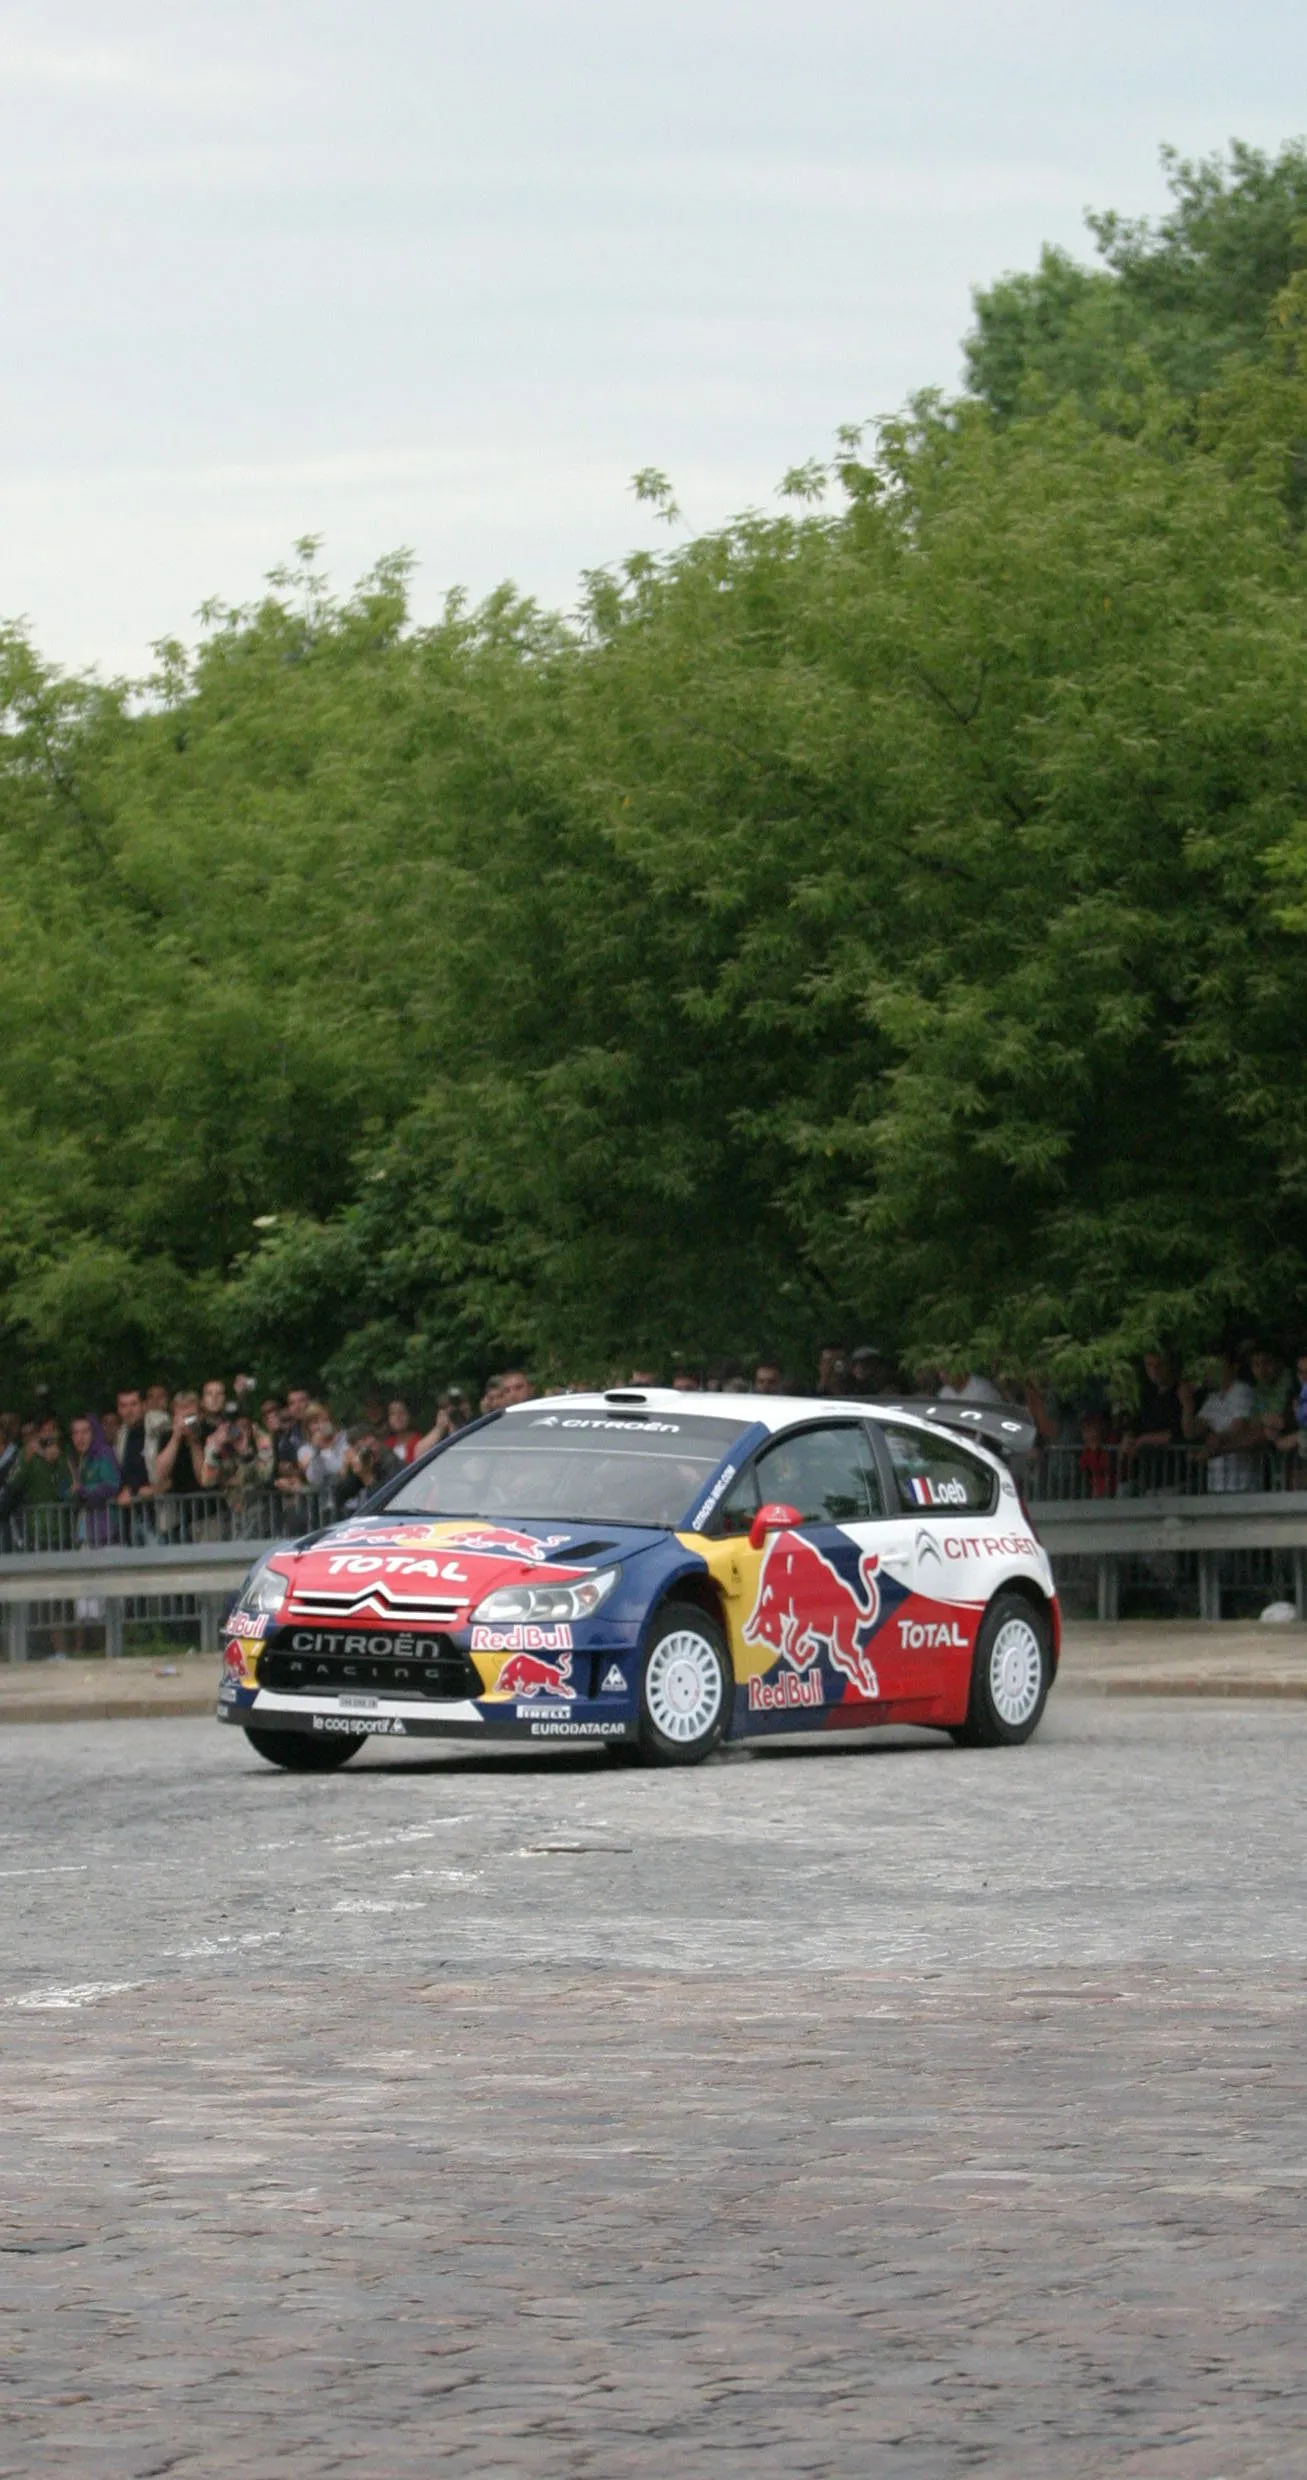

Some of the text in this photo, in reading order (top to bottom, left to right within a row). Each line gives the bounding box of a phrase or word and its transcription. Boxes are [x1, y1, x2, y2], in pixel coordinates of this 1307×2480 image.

[928, 1477, 968, 1505] Loeb
[328, 1554, 468, 1582] TOTAL
[897, 1619, 969, 1649] TOTAL
[290, 1661, 440, 1679] RACING
[516, 1704, 571, 1719] PIRELLI
[530, 1722, 626, 1736] EURODATACAR
